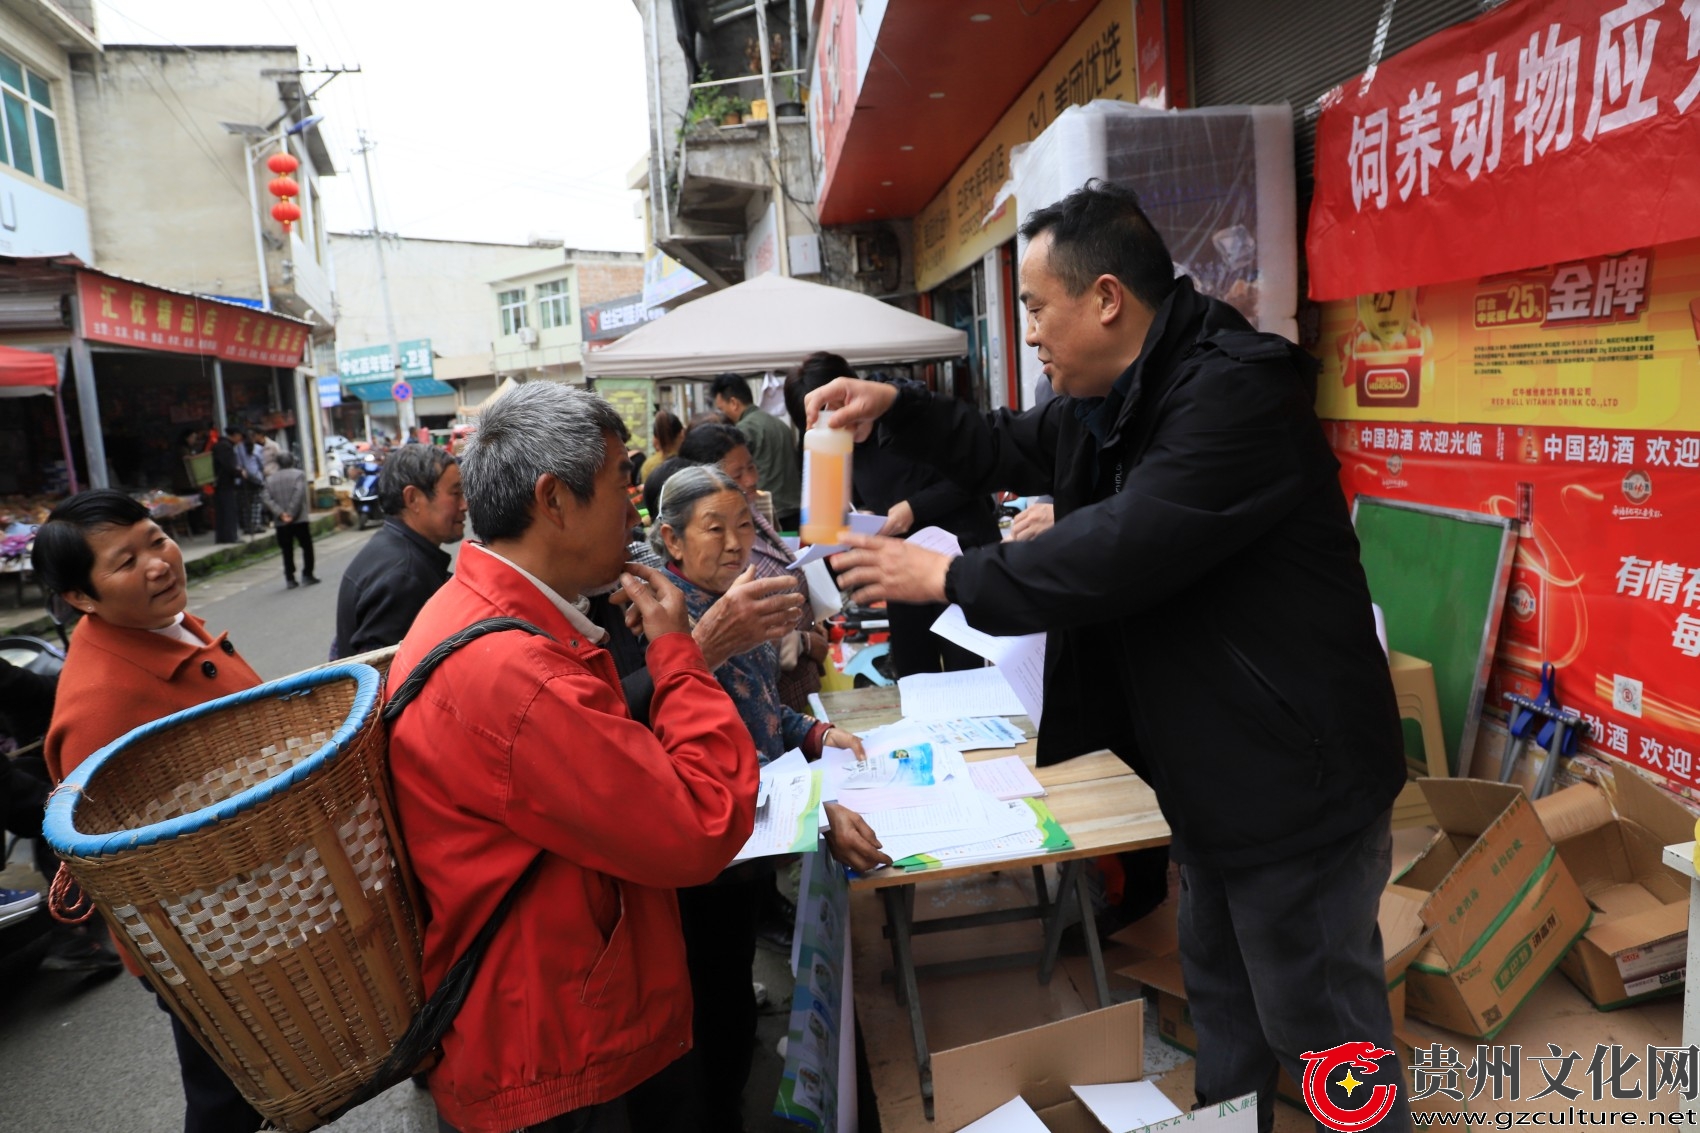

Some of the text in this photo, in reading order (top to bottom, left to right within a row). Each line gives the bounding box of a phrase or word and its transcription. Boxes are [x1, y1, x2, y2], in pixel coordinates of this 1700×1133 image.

[1054, 19, 1123, 114] 美团优选
[1546, 255, 1648, 321] 金牌
[1491, 398, 1505, 406] RED
[1506, 398, 1523, 406] BULL
[1526, 398, 1556, 406] VITAMIN
[1558, 398, 1583, 407] DRINK
[1361, 427, 1414, 451] 中国劲酒
[1418, 430, 1482, 456] 欢迎光临
[1544, 433, 1700, 467] 中国劲酒 欢迎
[1640, 735, 1700, 785] 欢迎
